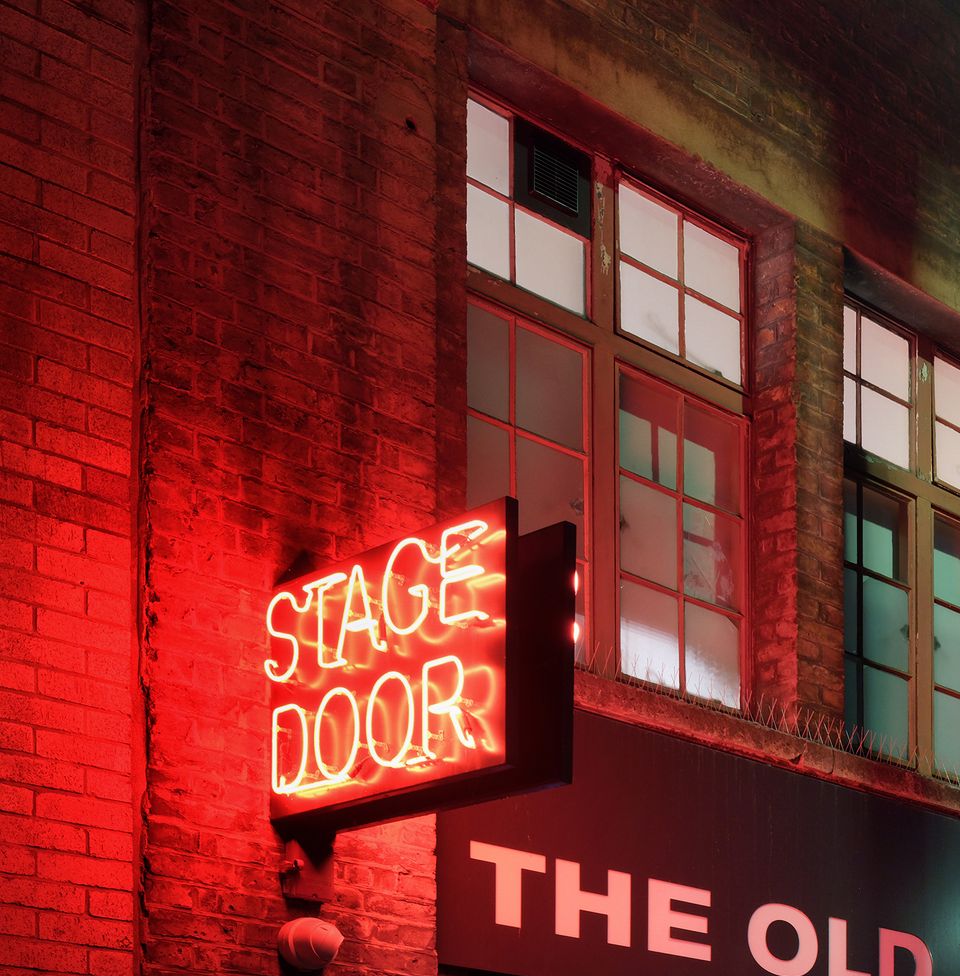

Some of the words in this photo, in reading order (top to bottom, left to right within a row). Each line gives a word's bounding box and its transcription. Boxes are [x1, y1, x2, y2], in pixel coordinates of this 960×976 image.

[264, 519, 490, 683] STAGE
[271, 655, 476, 794] DOOR
[469, 840, 712, 961] THE
